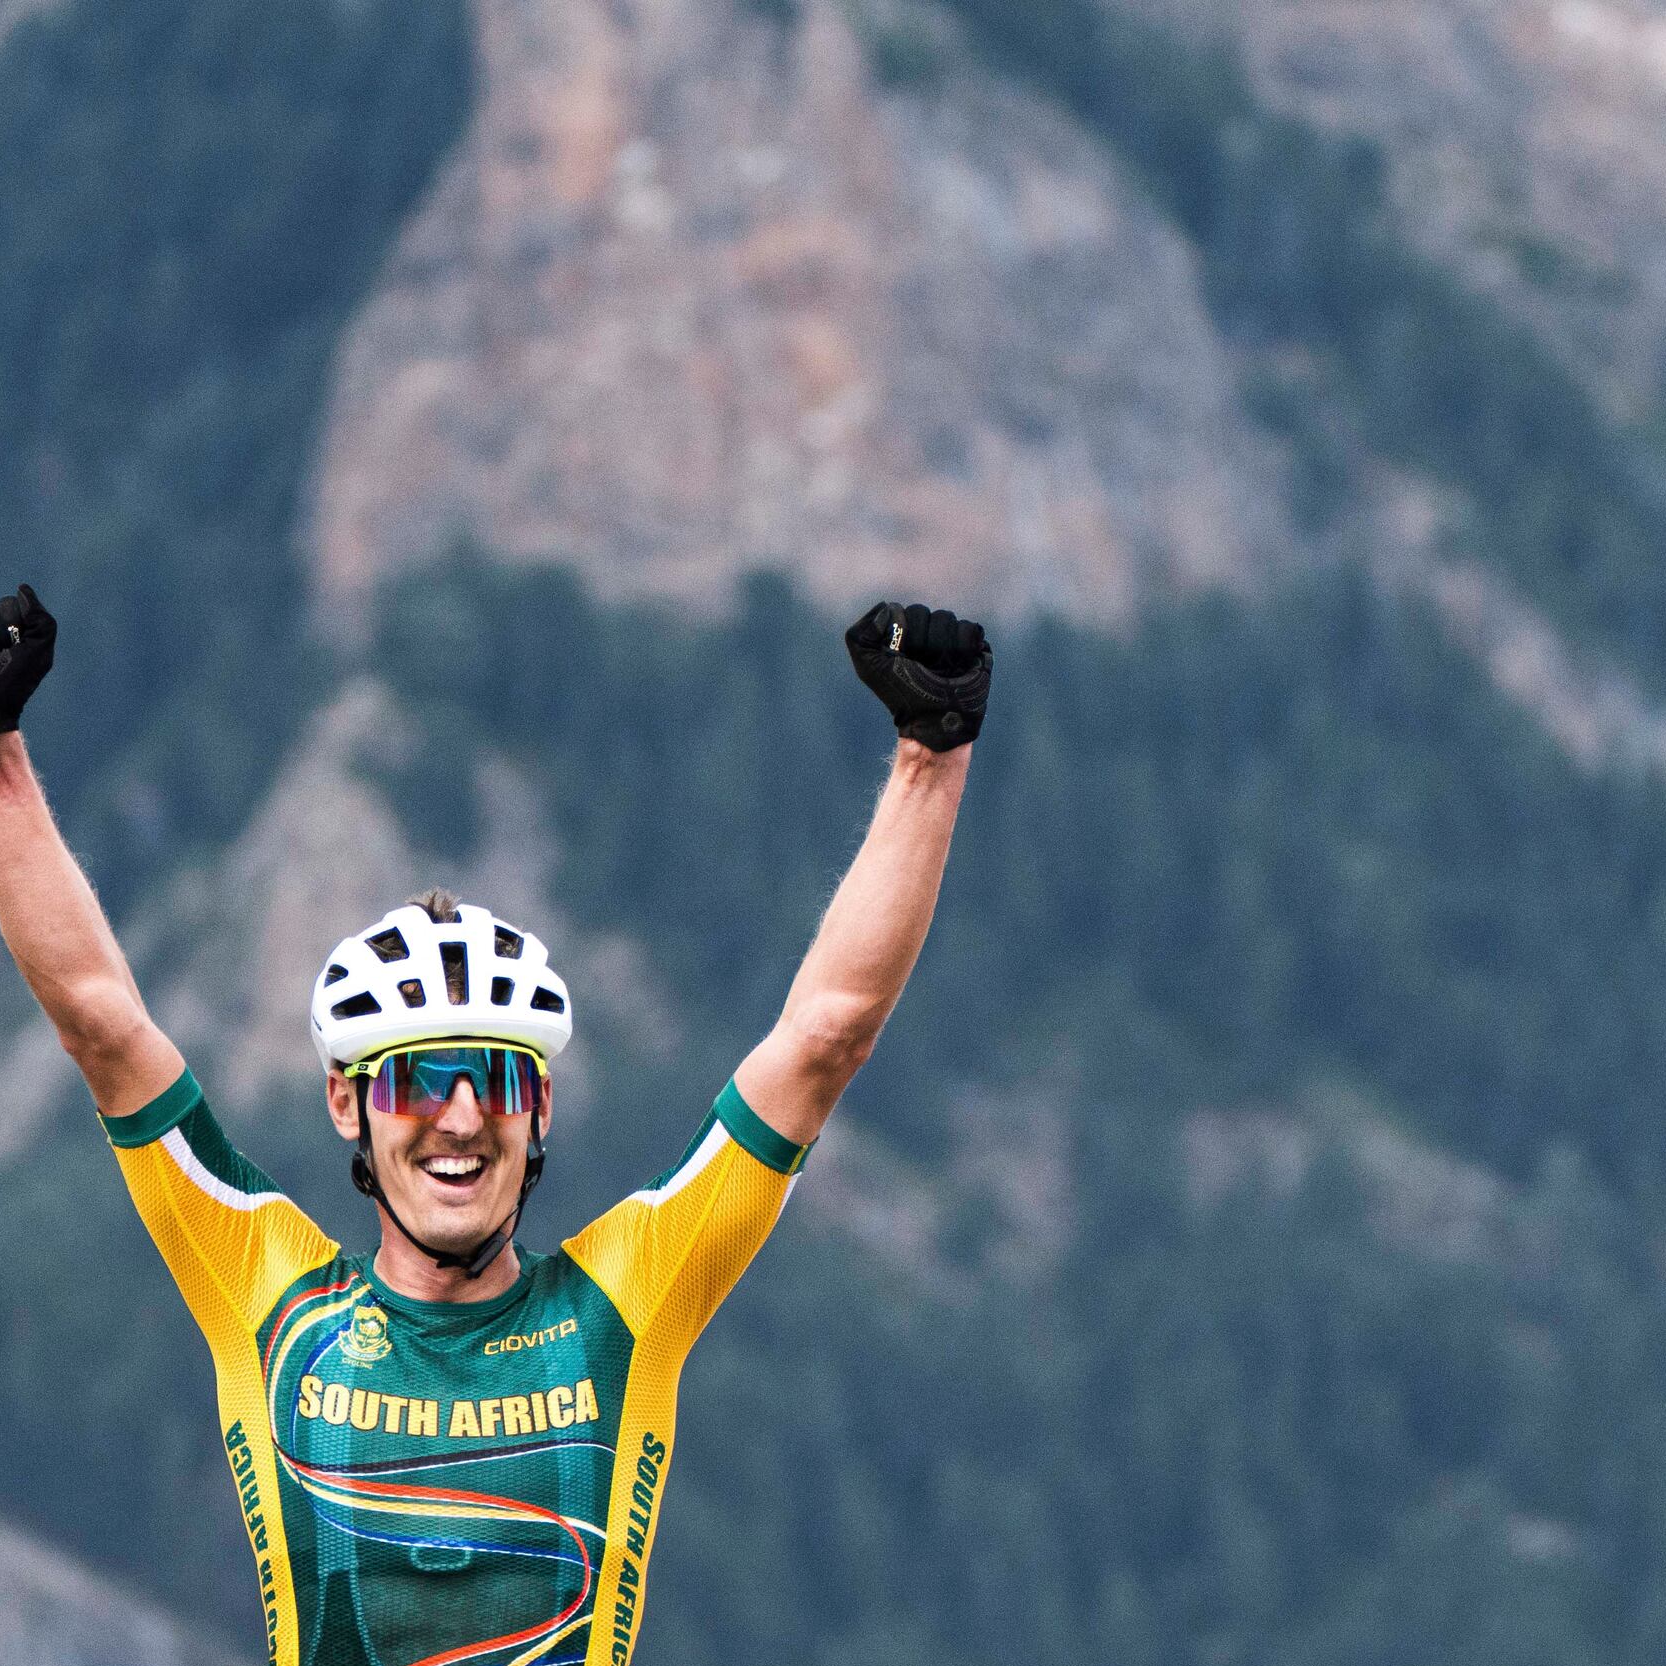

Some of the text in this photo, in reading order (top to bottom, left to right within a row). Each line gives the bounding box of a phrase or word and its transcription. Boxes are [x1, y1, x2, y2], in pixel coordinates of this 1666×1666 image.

[483, 1318, 578, 1356] CIOVITA
[297, 1373, 601, 1437] SOUTH AFRICA
[627, 1431, 667, 1560] SOUTH
